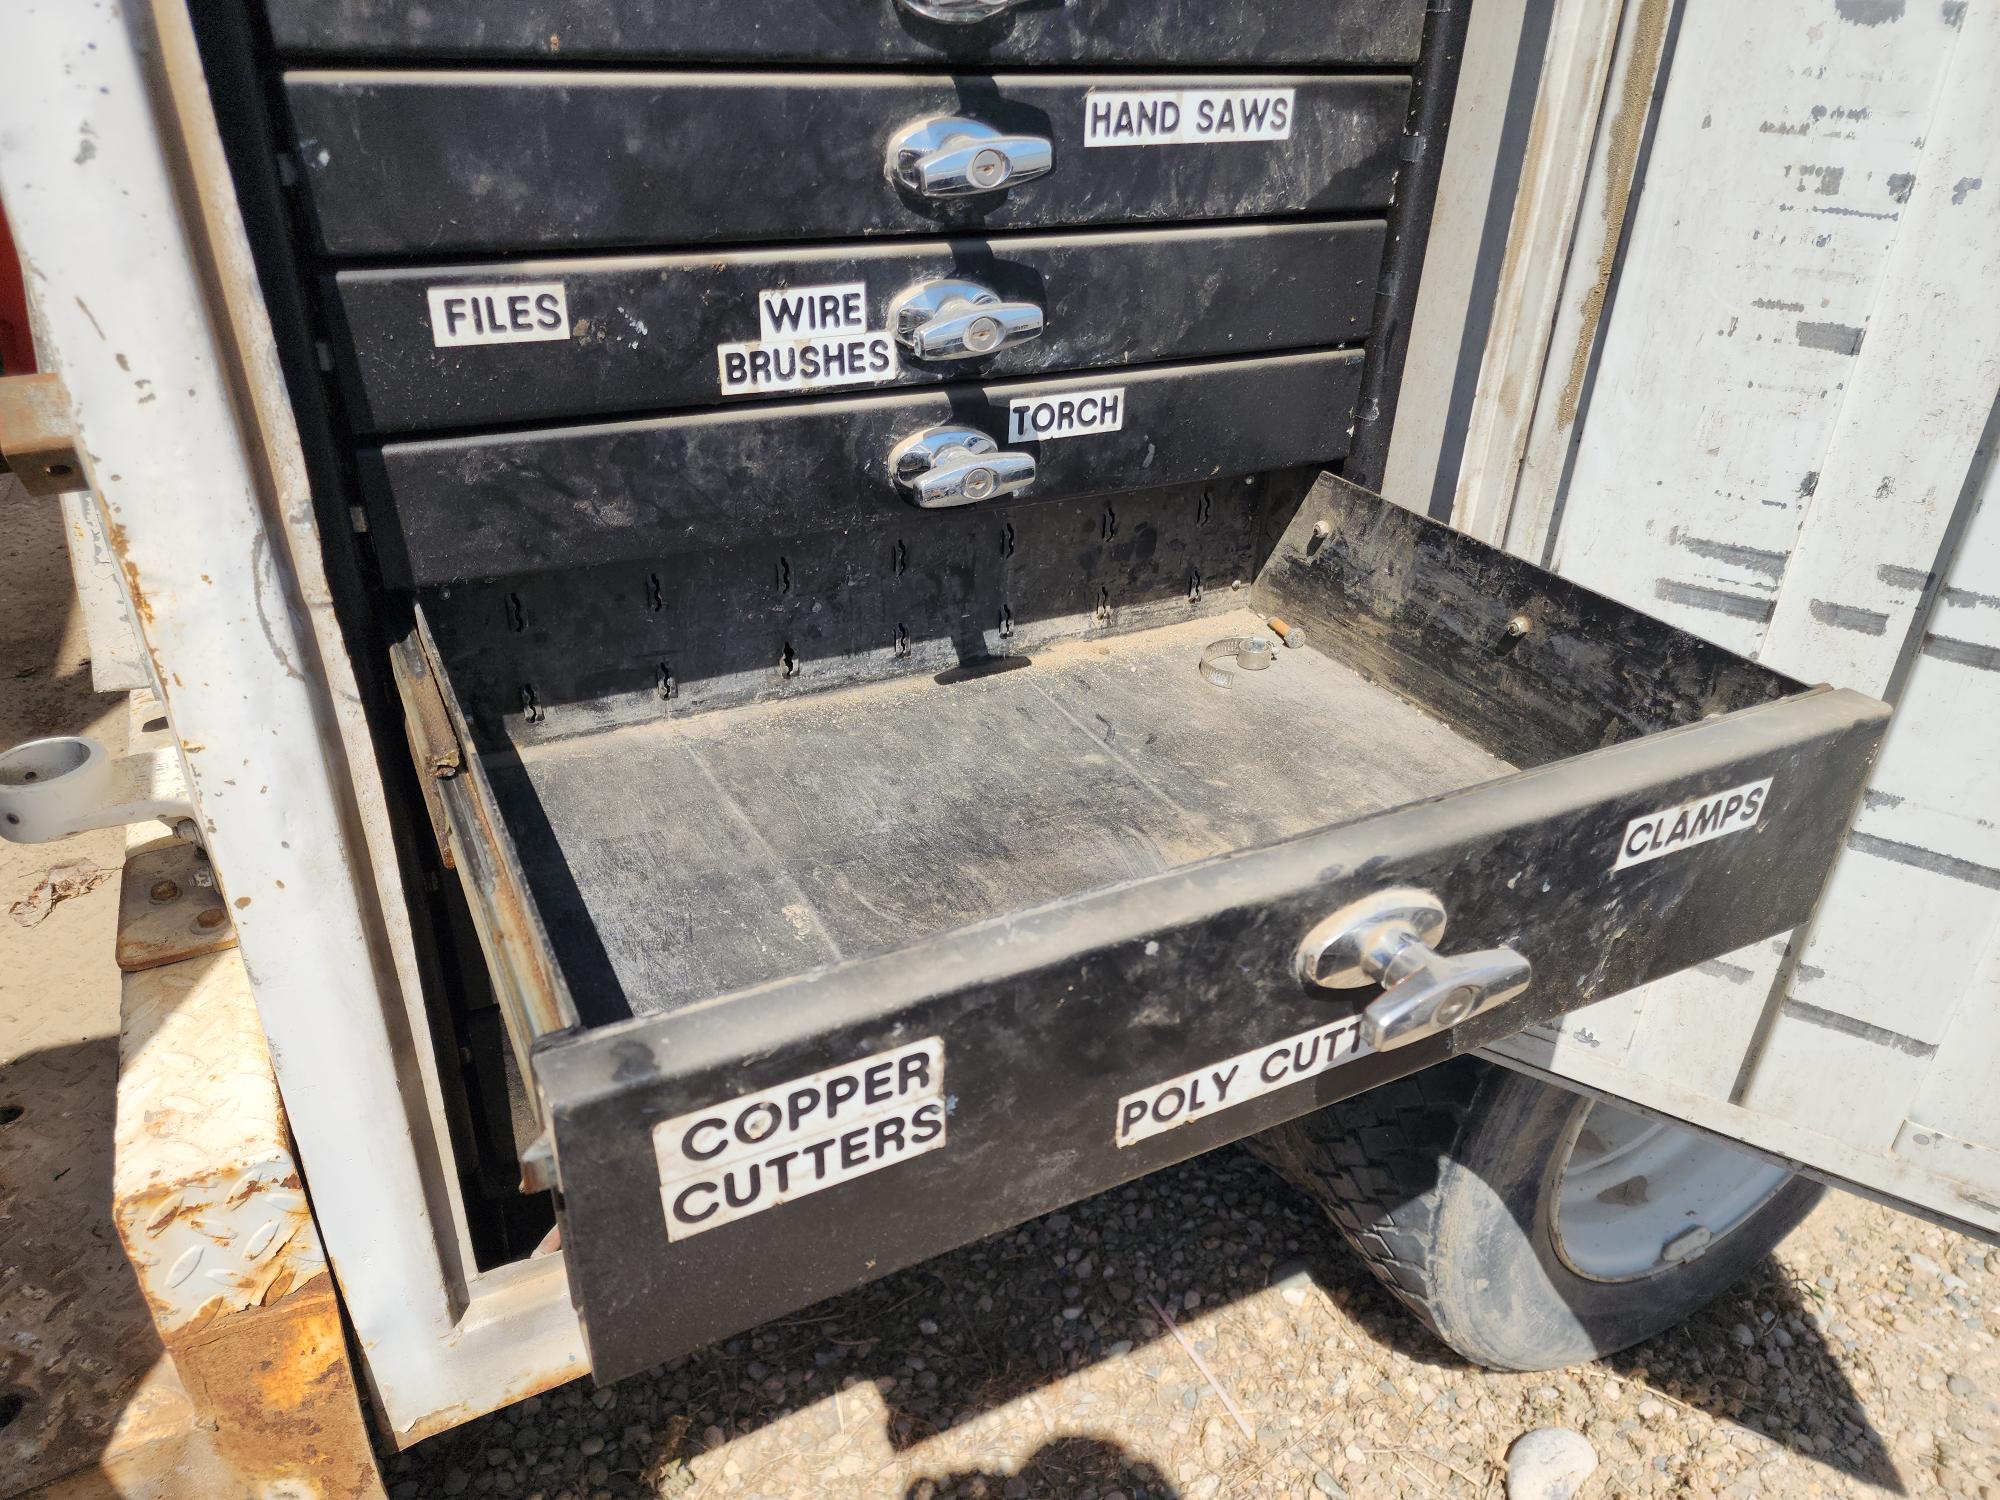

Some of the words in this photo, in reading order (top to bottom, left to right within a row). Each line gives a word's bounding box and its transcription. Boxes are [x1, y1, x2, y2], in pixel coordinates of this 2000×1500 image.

[1091, 100, 1180, 138] HAND
[1196, 97, 1288, 136] SAWS
[444, 293, 562, 337] FILES
[764, 292, 863, 334] WIRE
[725, 339, 890, 385] BRUSHES
[1013, 395, 1119, 435] TORCH
[1625, 787, 1764, 858] CLAMPS
[1121, 1064, 1239, 1138] POLY
[1260, 1020, 1361, 1084] CUTT
[681, 1052, 930, 1161] COPPER
[673, 1104, 943, 1224] CUTTERS
